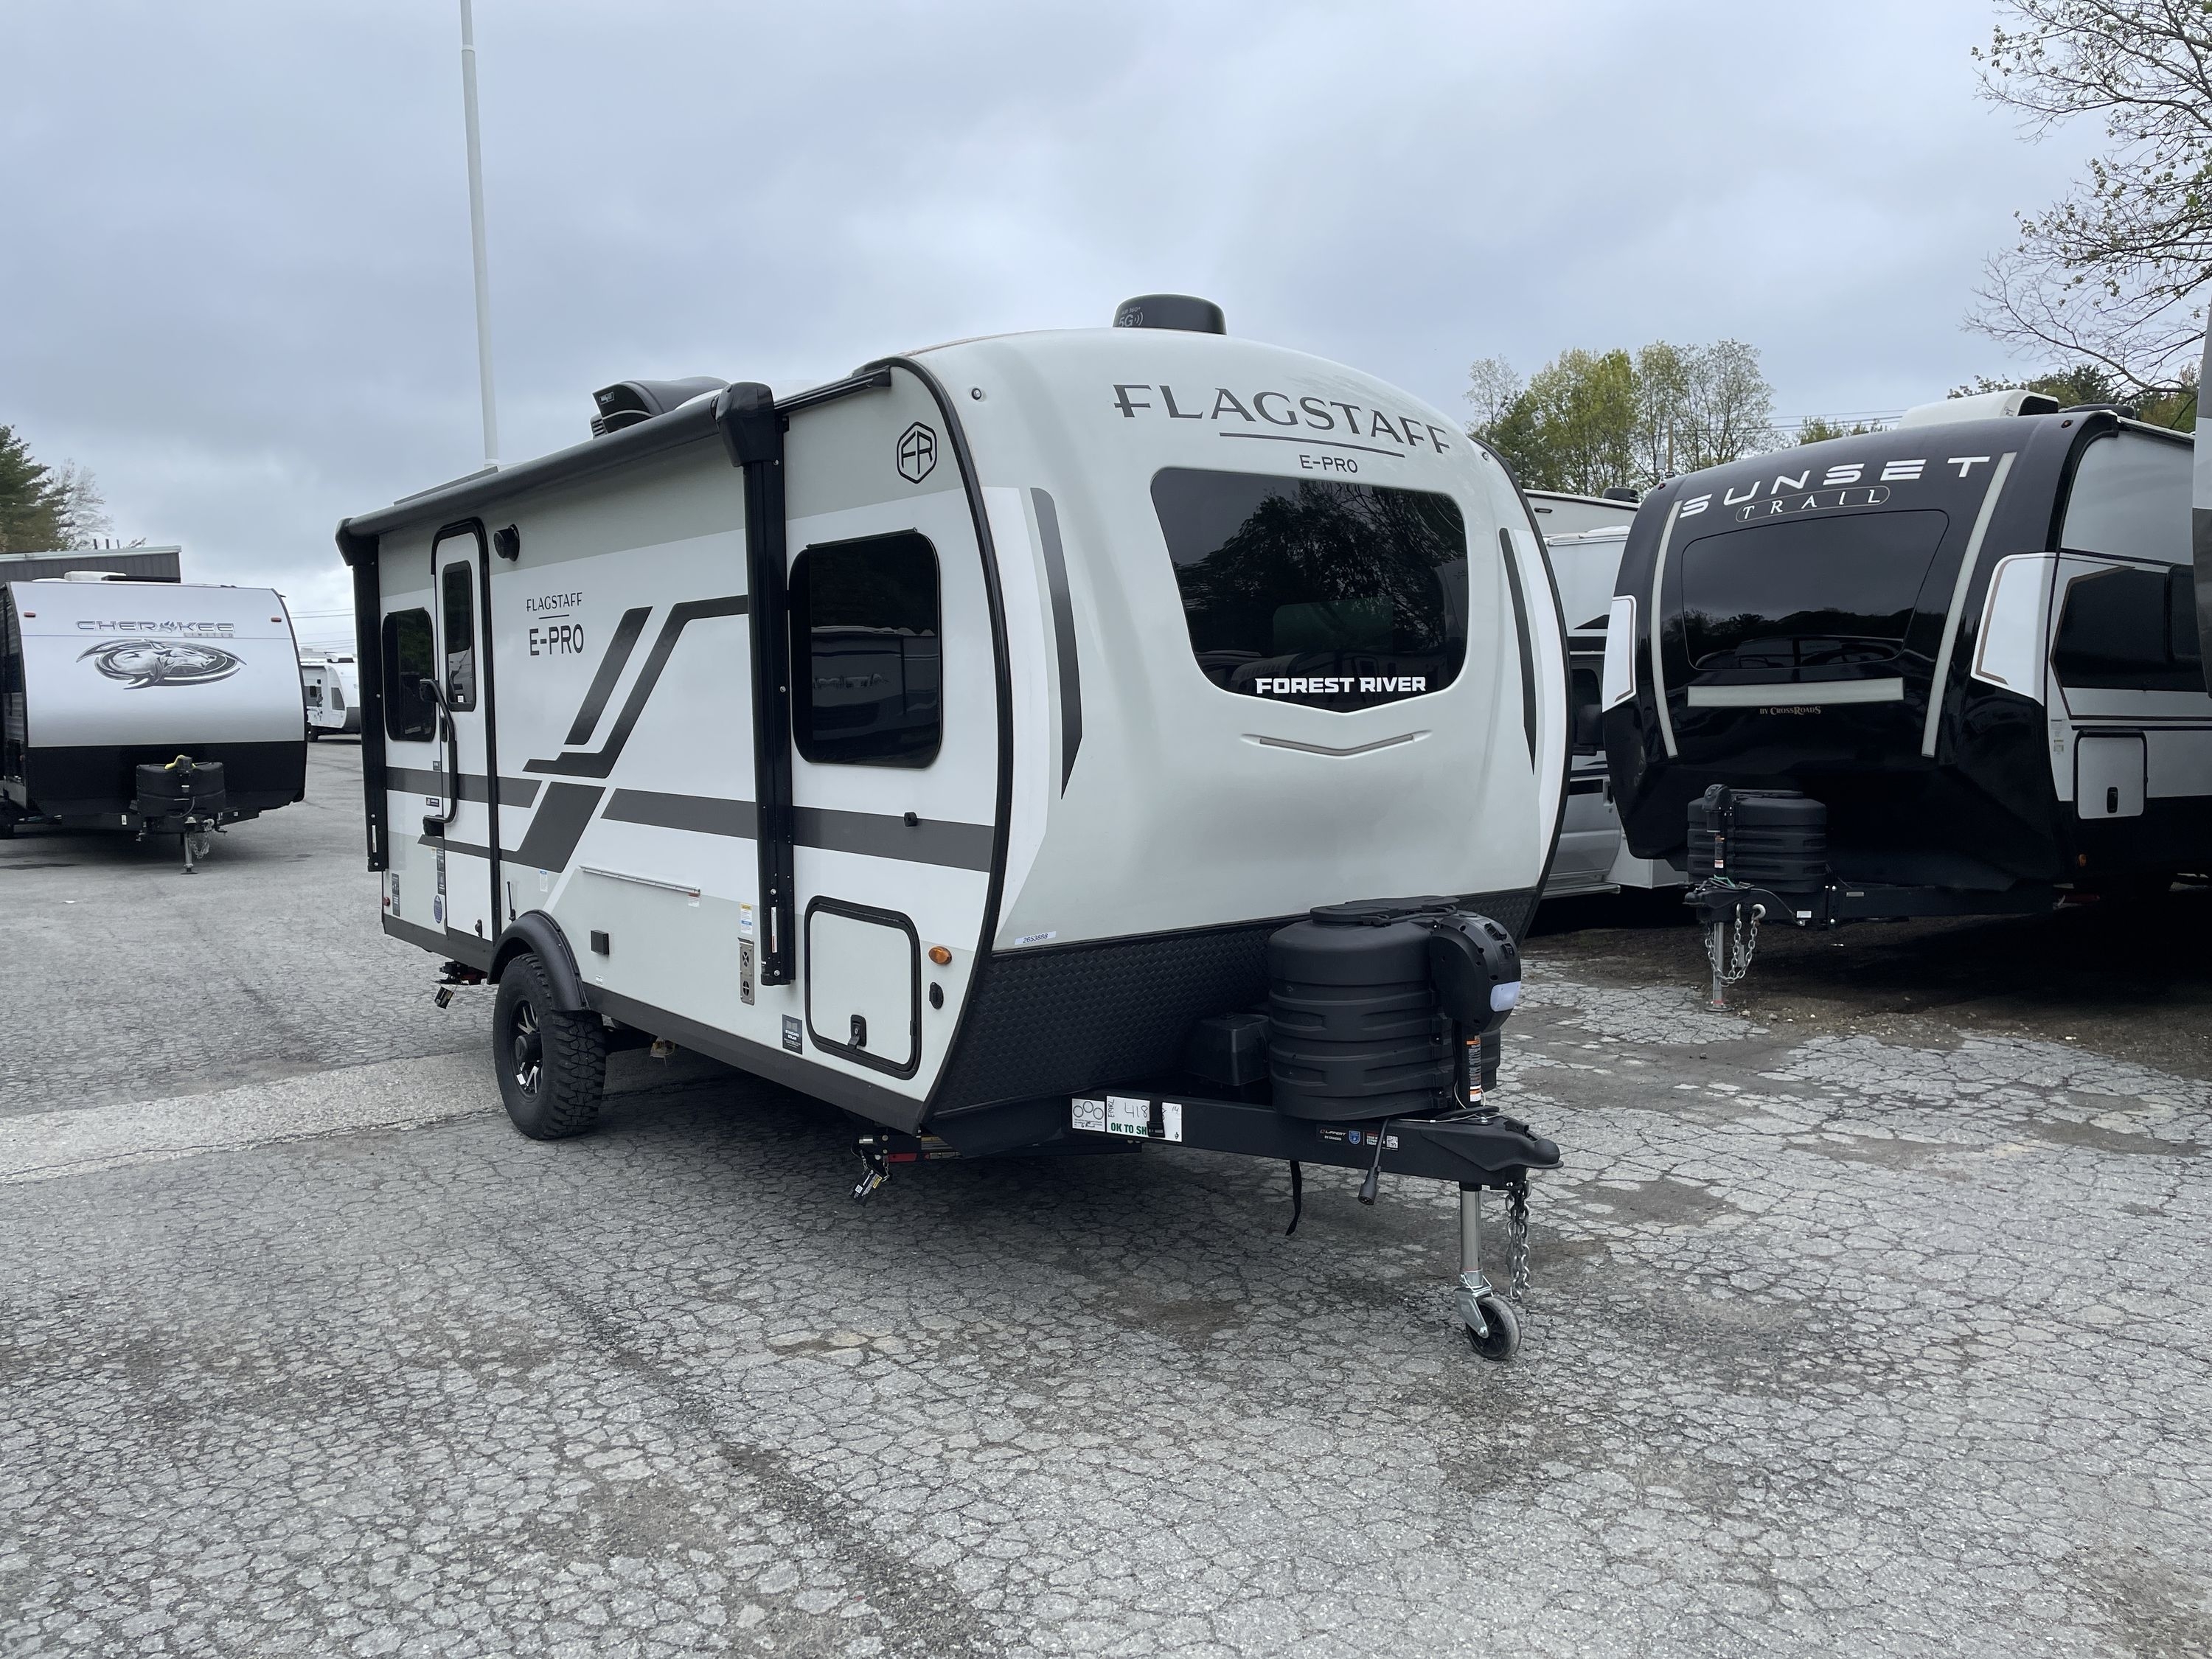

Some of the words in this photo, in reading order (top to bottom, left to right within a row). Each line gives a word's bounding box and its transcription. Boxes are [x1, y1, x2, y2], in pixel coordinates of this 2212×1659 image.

[1119, 314, 1133, 327] 5G
[1113, 383, 1450, 454] FLAGSTAFF
[1298, 454, 1358, 473] E-PRO
[1680, 456, 1990, 518] SUNSET
[1742, 490, 1881, 520] TRAIL
[526, 592, 582, 612] FLAGSTAFF
[76, 620, 235, 633] CHEROKEE
[529, 623, 584, 656] E-PRO
[1254, 677, 1354, 694] FOREST
[1358, 676, 1426, 692] RIVER
[1023, 933, 1048, 944] 2653888
[1110, 1122, 1121, 1133] OK
[1124, 1124, 1134, 1133] TO
[1136, 1125, 1147, 1135] SH
